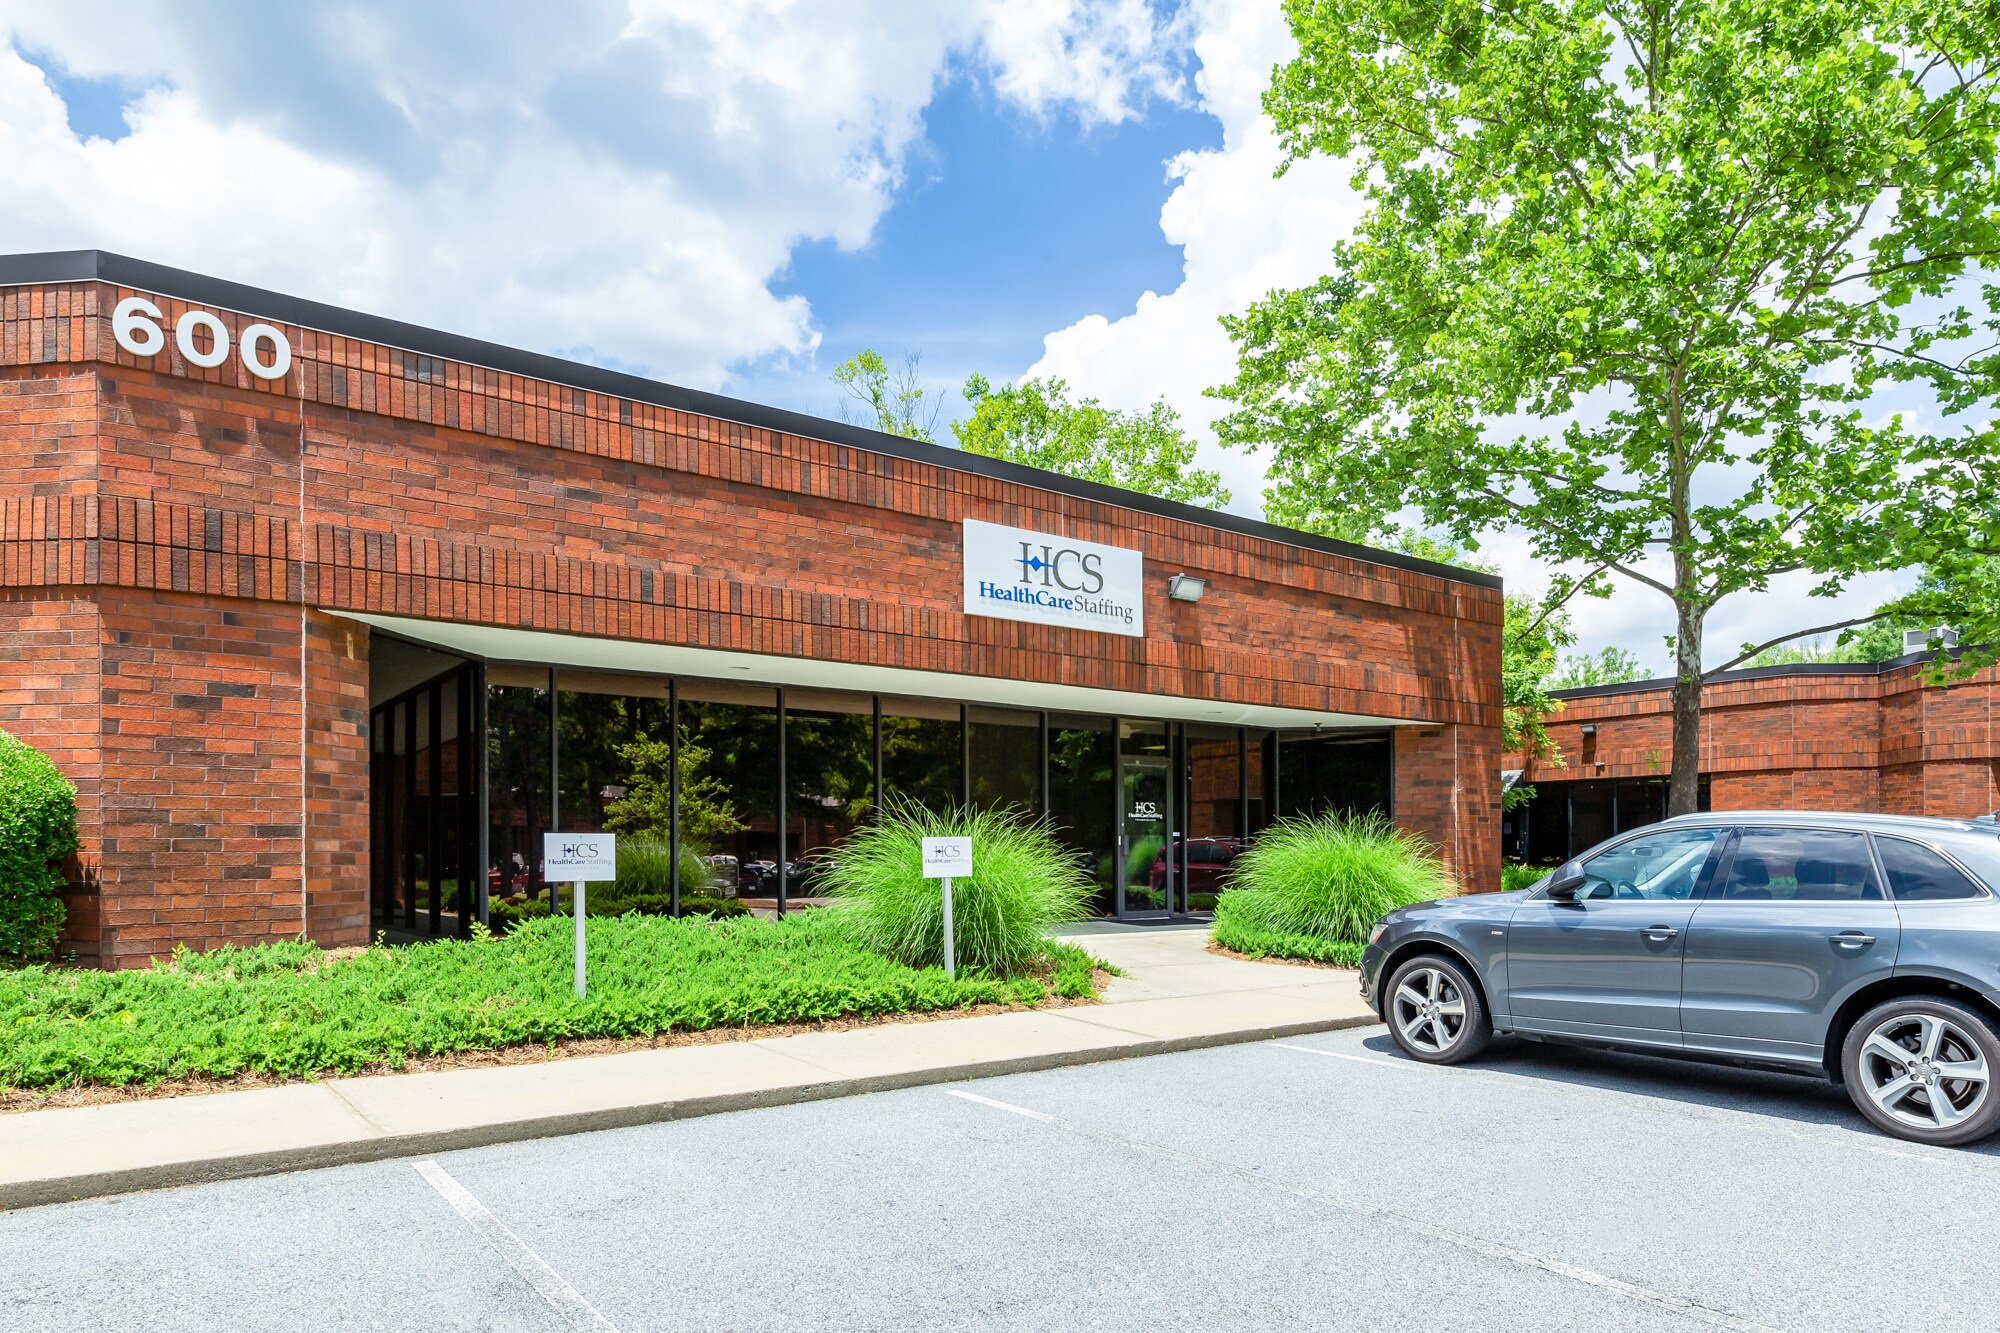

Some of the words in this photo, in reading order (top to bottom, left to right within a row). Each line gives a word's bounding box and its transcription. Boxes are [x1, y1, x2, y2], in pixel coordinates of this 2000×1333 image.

[111, 296, 292, 380] 600
[1016, 541, 1104, 594] HCS
[1134, 801, 1156, 813] HCS
[561, 843, 599, 858] HCS
[934, 845, 961, 858] HCS
